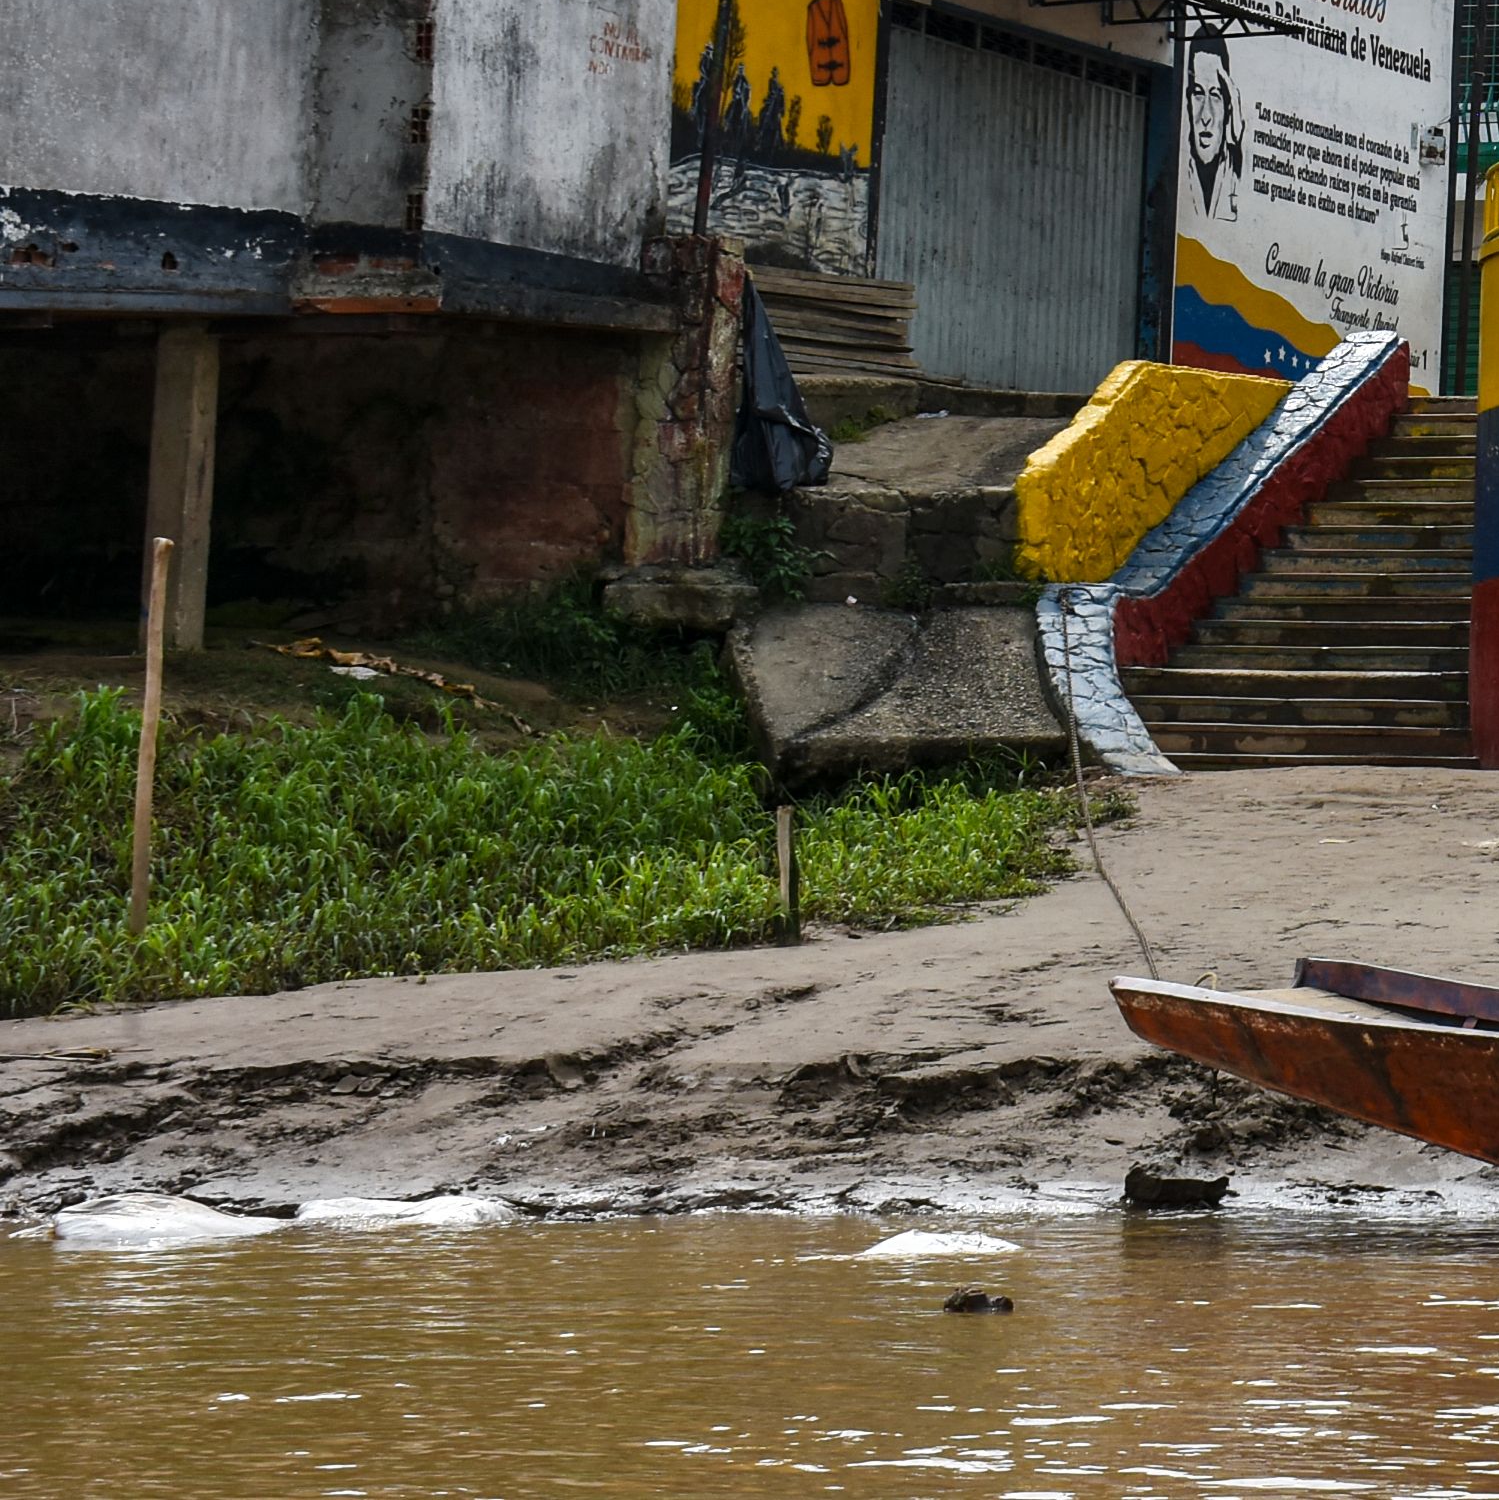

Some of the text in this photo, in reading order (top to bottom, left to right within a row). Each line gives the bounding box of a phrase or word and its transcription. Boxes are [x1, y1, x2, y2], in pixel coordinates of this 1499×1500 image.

[1351, 27, 1367, 62] de
[1370, 33, 1432, 83] Venezuela
[1273, 110, 1303, 135] consejos
[1305, 121, 1343, 144] comunales
[1344, 132, 1357, 149] son
[1359, 132, 1365, 151] el
[1394, 143, 1402, 162] de
[1402, 146, 1410, 164] la
[1293, 141, 1306, 160] por
[1307, 145, 1320, 165] que
[1322, 146, 1342, 169] ahora
[1352, 154, 1358, 172] el
[1359, 159, 1379, 179] poder
[1380, 167, 1405, 187] popular
[1298, 164, 1328, 187] echando
[1351, 181, 1356, 200] y
[1373, 188, 1381, 202] en
[1382, 186, 1389, 204] la
[1271, 183, 1296, 203] grande
[1298, 186, 1307, 206] de
[1308, 193, 1317, 209] su
[1337, 202, 1346, 217] en
[1347, 201, 1354, 219] el
[1266, 242, 1399, 306] Comuna la gran Victoria
[1329, 296, 1370, 331] Transporte
